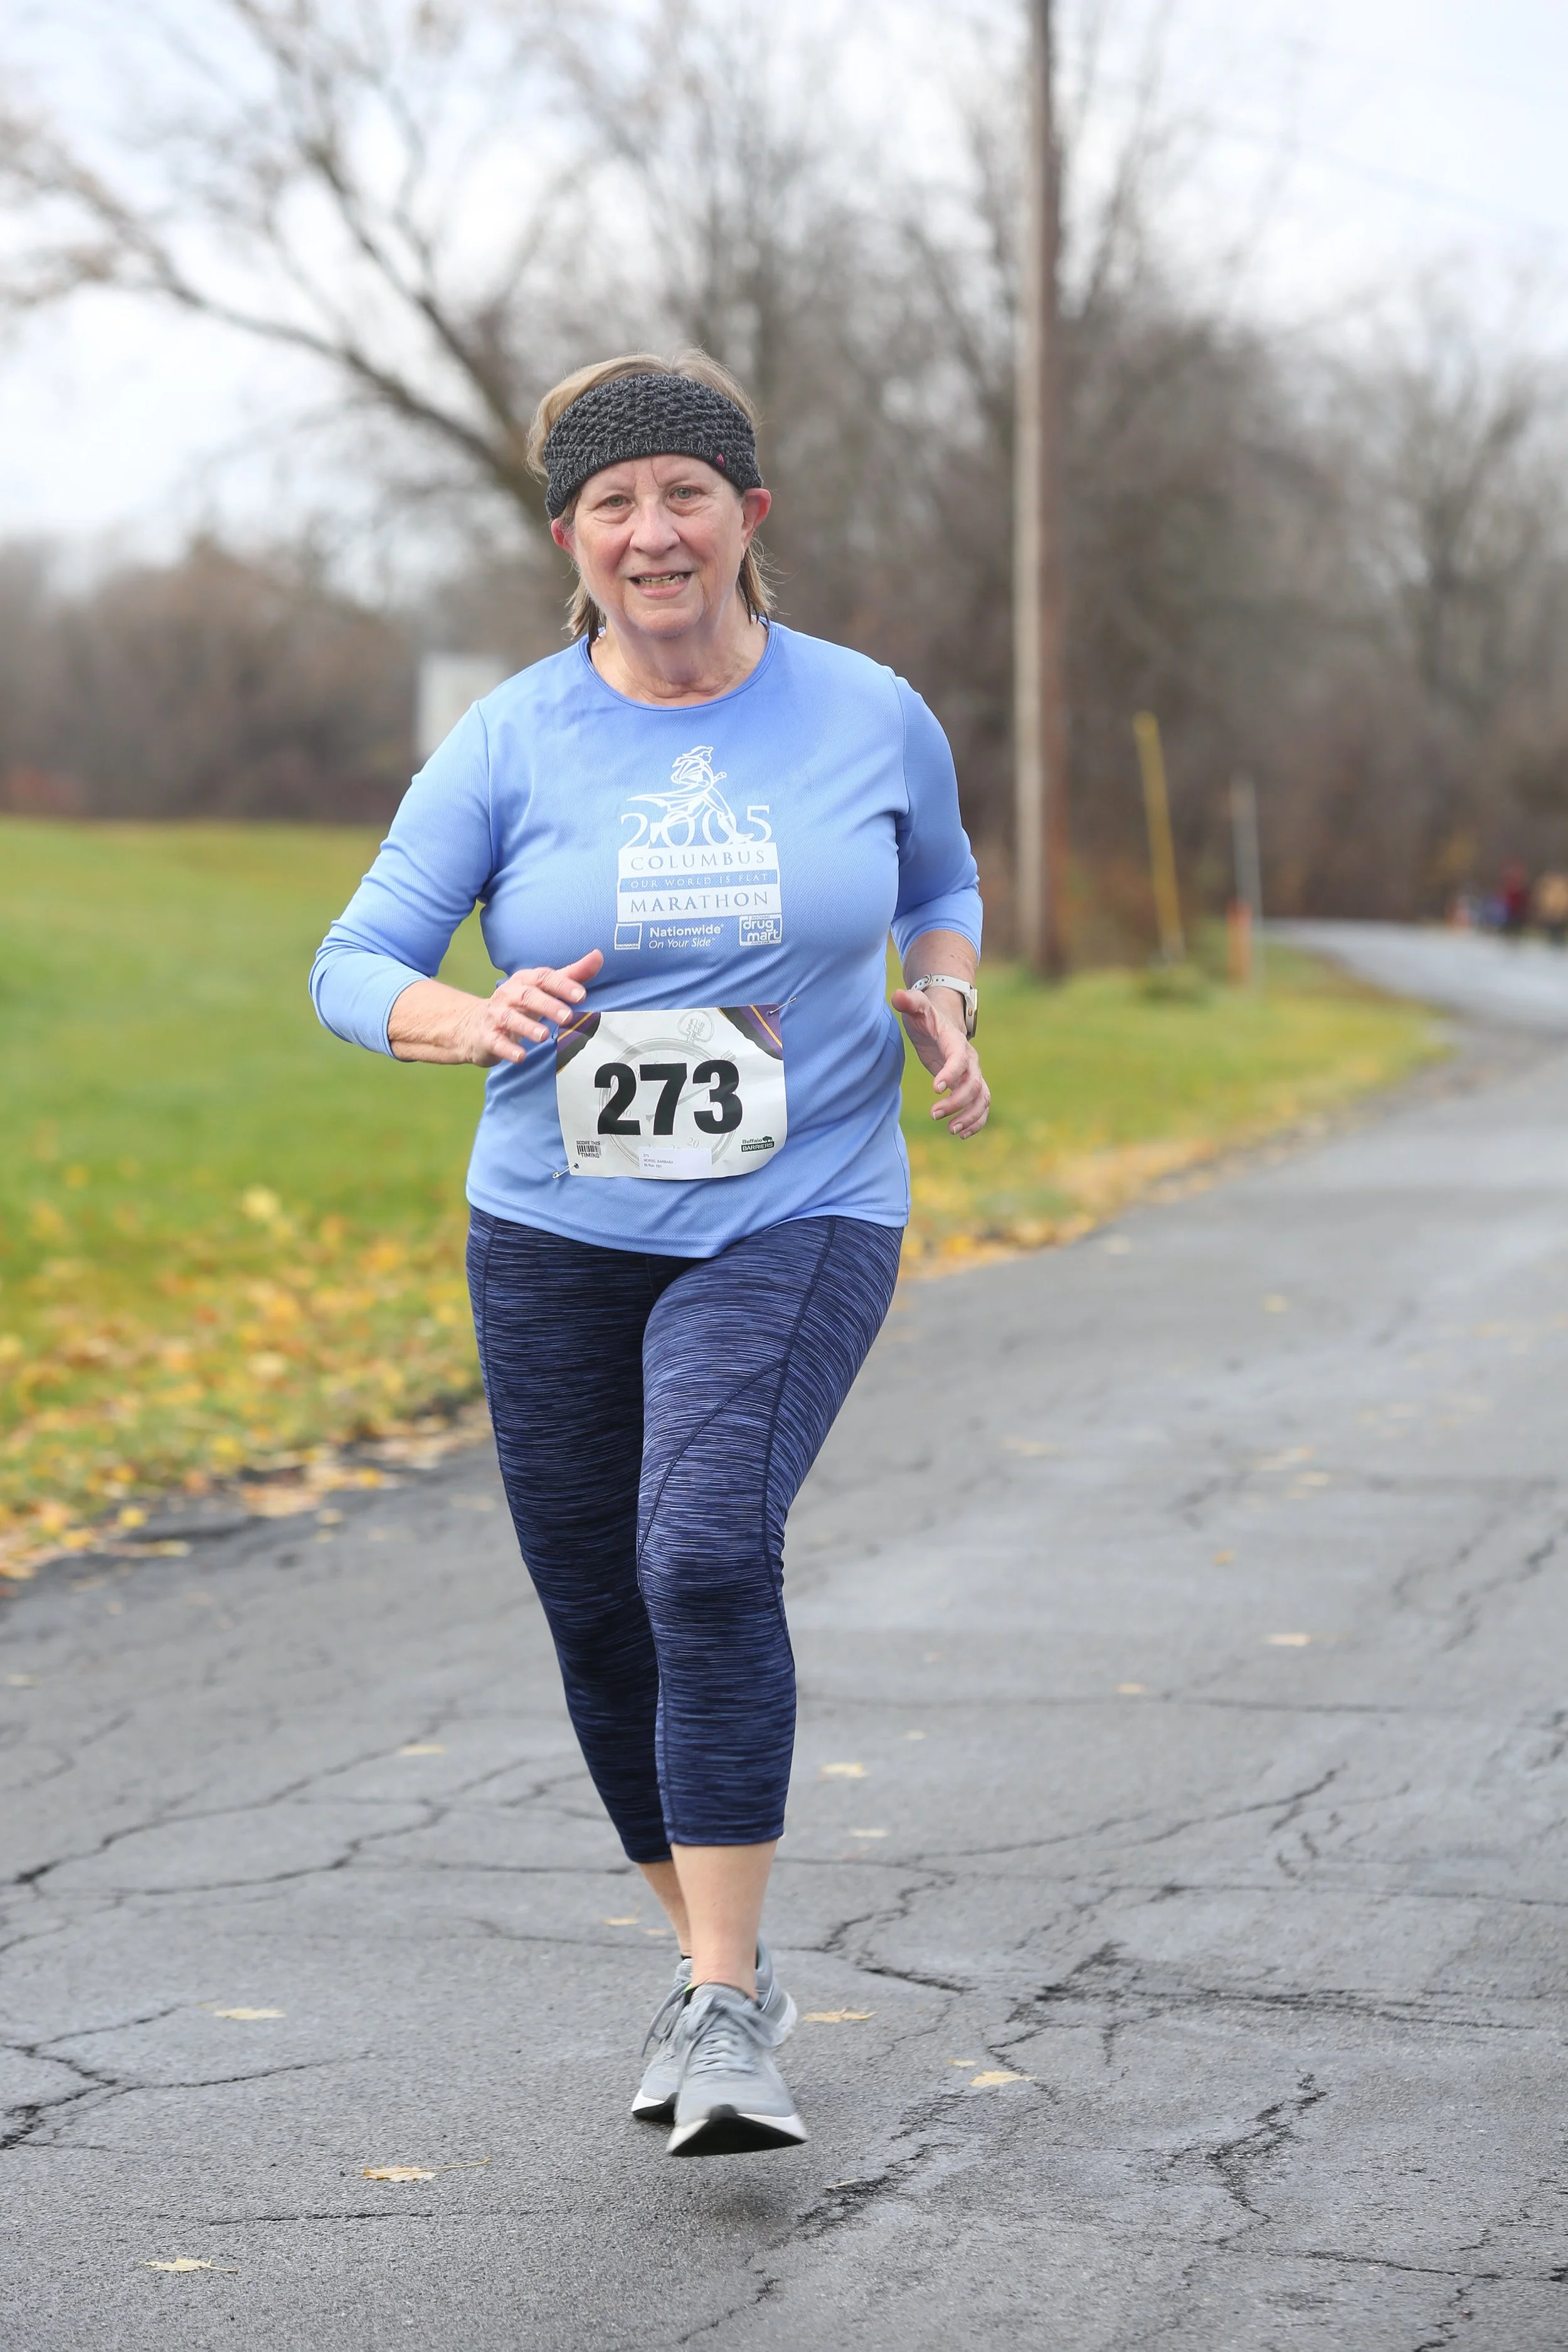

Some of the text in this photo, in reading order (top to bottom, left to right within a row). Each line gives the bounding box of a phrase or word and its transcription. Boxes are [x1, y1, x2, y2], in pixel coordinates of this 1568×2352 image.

[621, 805, 772, 849] 2005
[631, 850, 765, 871] COLUMBUS
[631, 873, 768, 889] OUR WORLD IS FLAT
[630, 891, 768, 913] MARATHON
[650, 924, 721, 938] Nationwide
[743, 915, 774, 932] drug
[649, 937, 711, 949] On Your Side
[747, 929, 781, 941] mart
[594, 1059, 743, 1136] 273
[742, 1142, 773, 1152] BARRIERS
